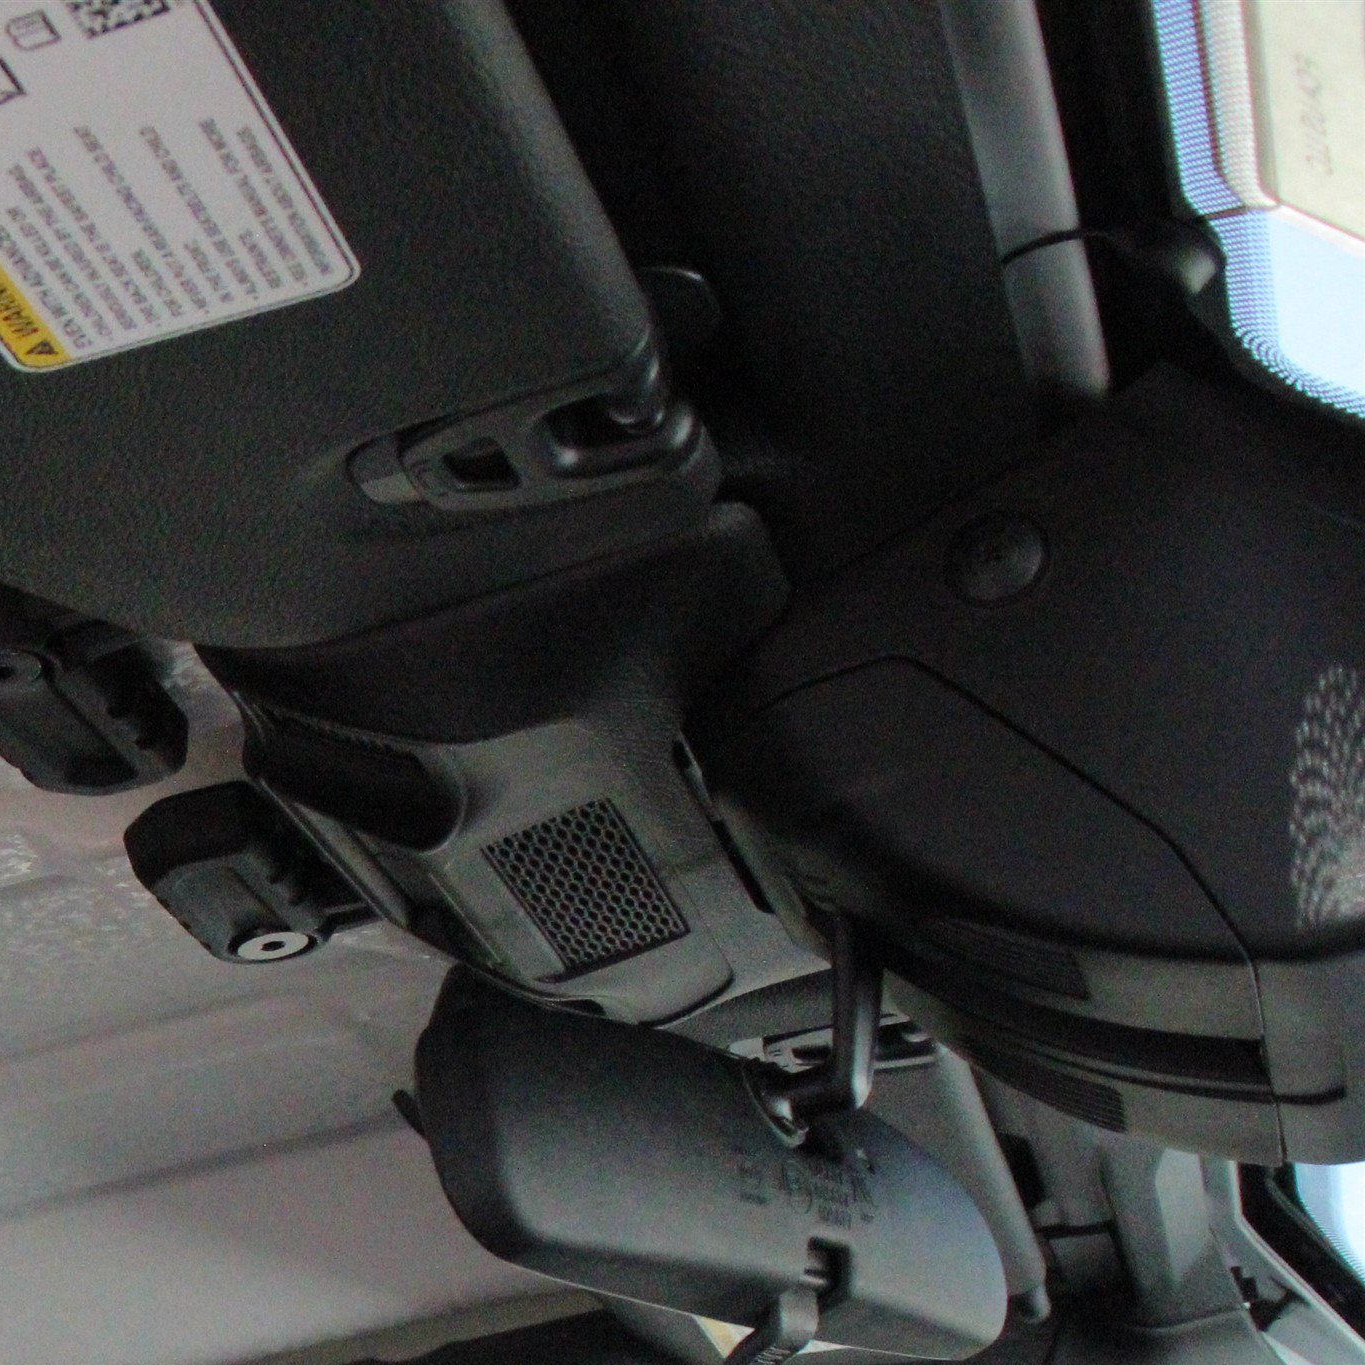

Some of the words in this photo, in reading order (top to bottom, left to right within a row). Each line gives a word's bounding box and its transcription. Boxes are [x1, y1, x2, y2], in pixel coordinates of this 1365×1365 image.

[54, 271, 79, 292] CAN
[34, 288, 69, 319] WITH
[69, 291, 113, 337] CHILDREN
[57, 317, 92, 349] EVEN
